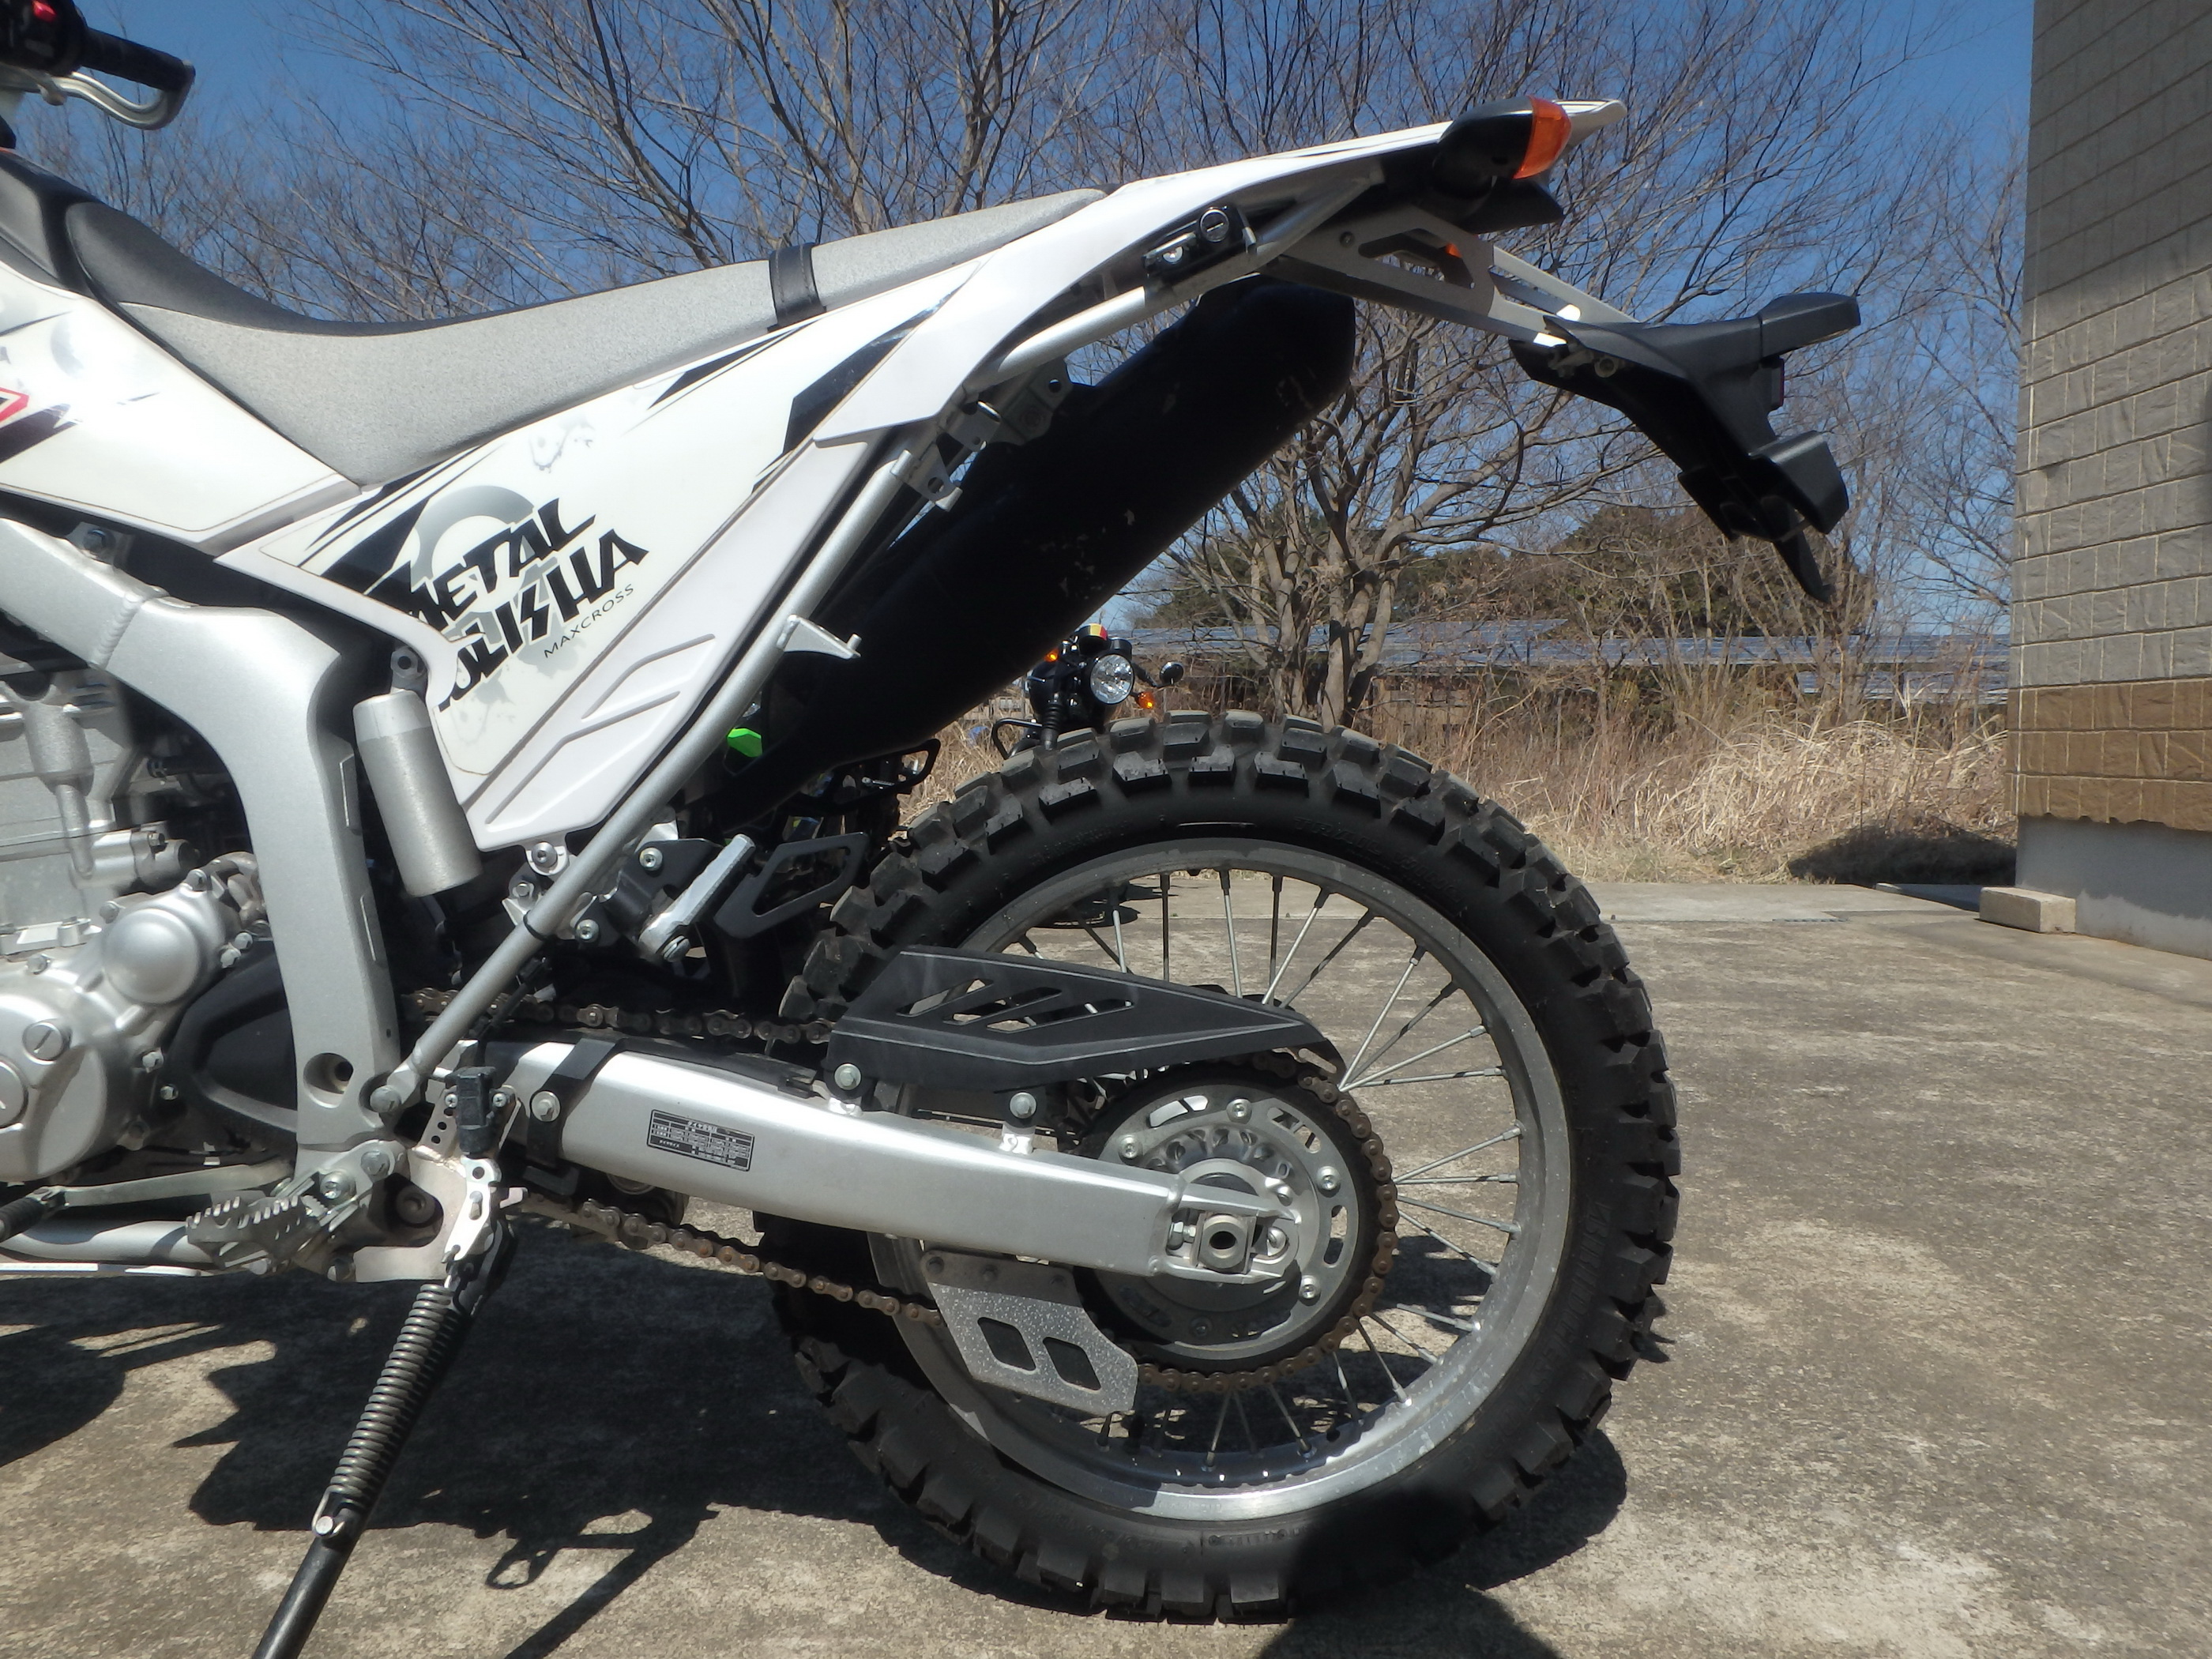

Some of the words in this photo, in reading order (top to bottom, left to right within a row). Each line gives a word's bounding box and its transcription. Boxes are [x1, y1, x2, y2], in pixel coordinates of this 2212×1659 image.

[364, 498, 596, 632] METAL
[438, 529, 649, 713] ULISHA
[544, 584, 634, 658] MAXCROSS
